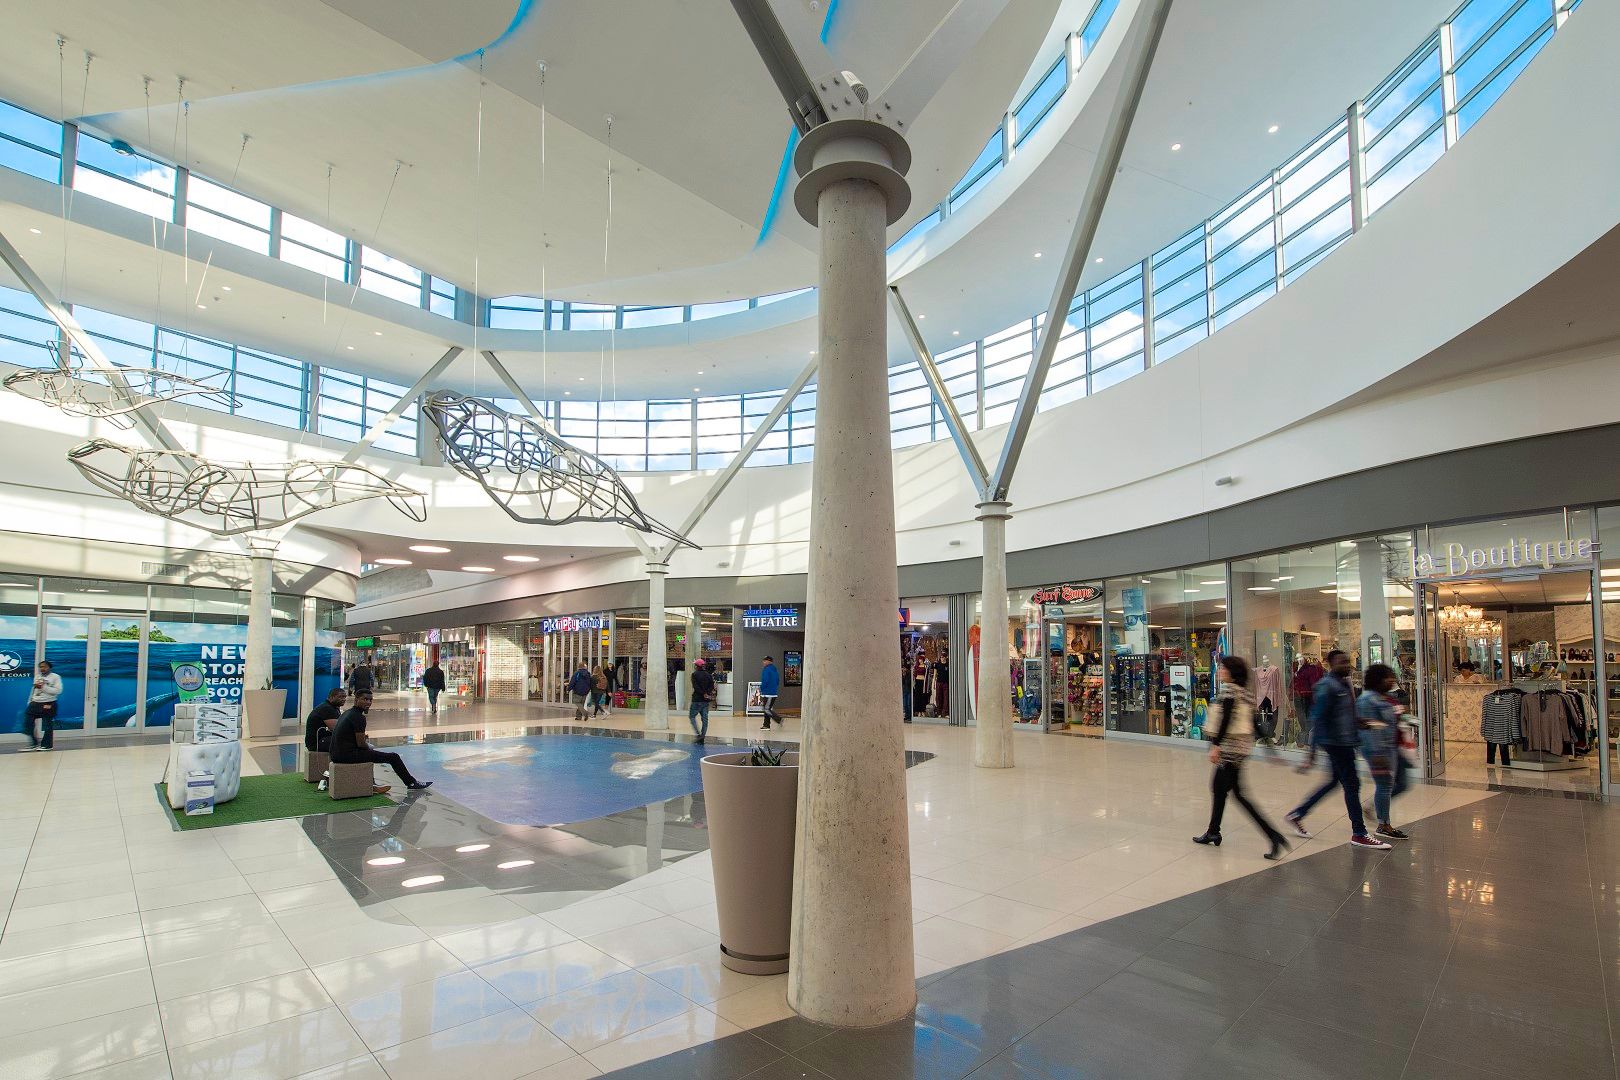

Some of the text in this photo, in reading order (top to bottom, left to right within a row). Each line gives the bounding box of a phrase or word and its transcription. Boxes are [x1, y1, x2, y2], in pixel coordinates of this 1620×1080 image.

[1443, 537, 1592, 577] Boutique
[743, 616, 798, 627] THEATRE
[204, 677, 243, 685] REACH
